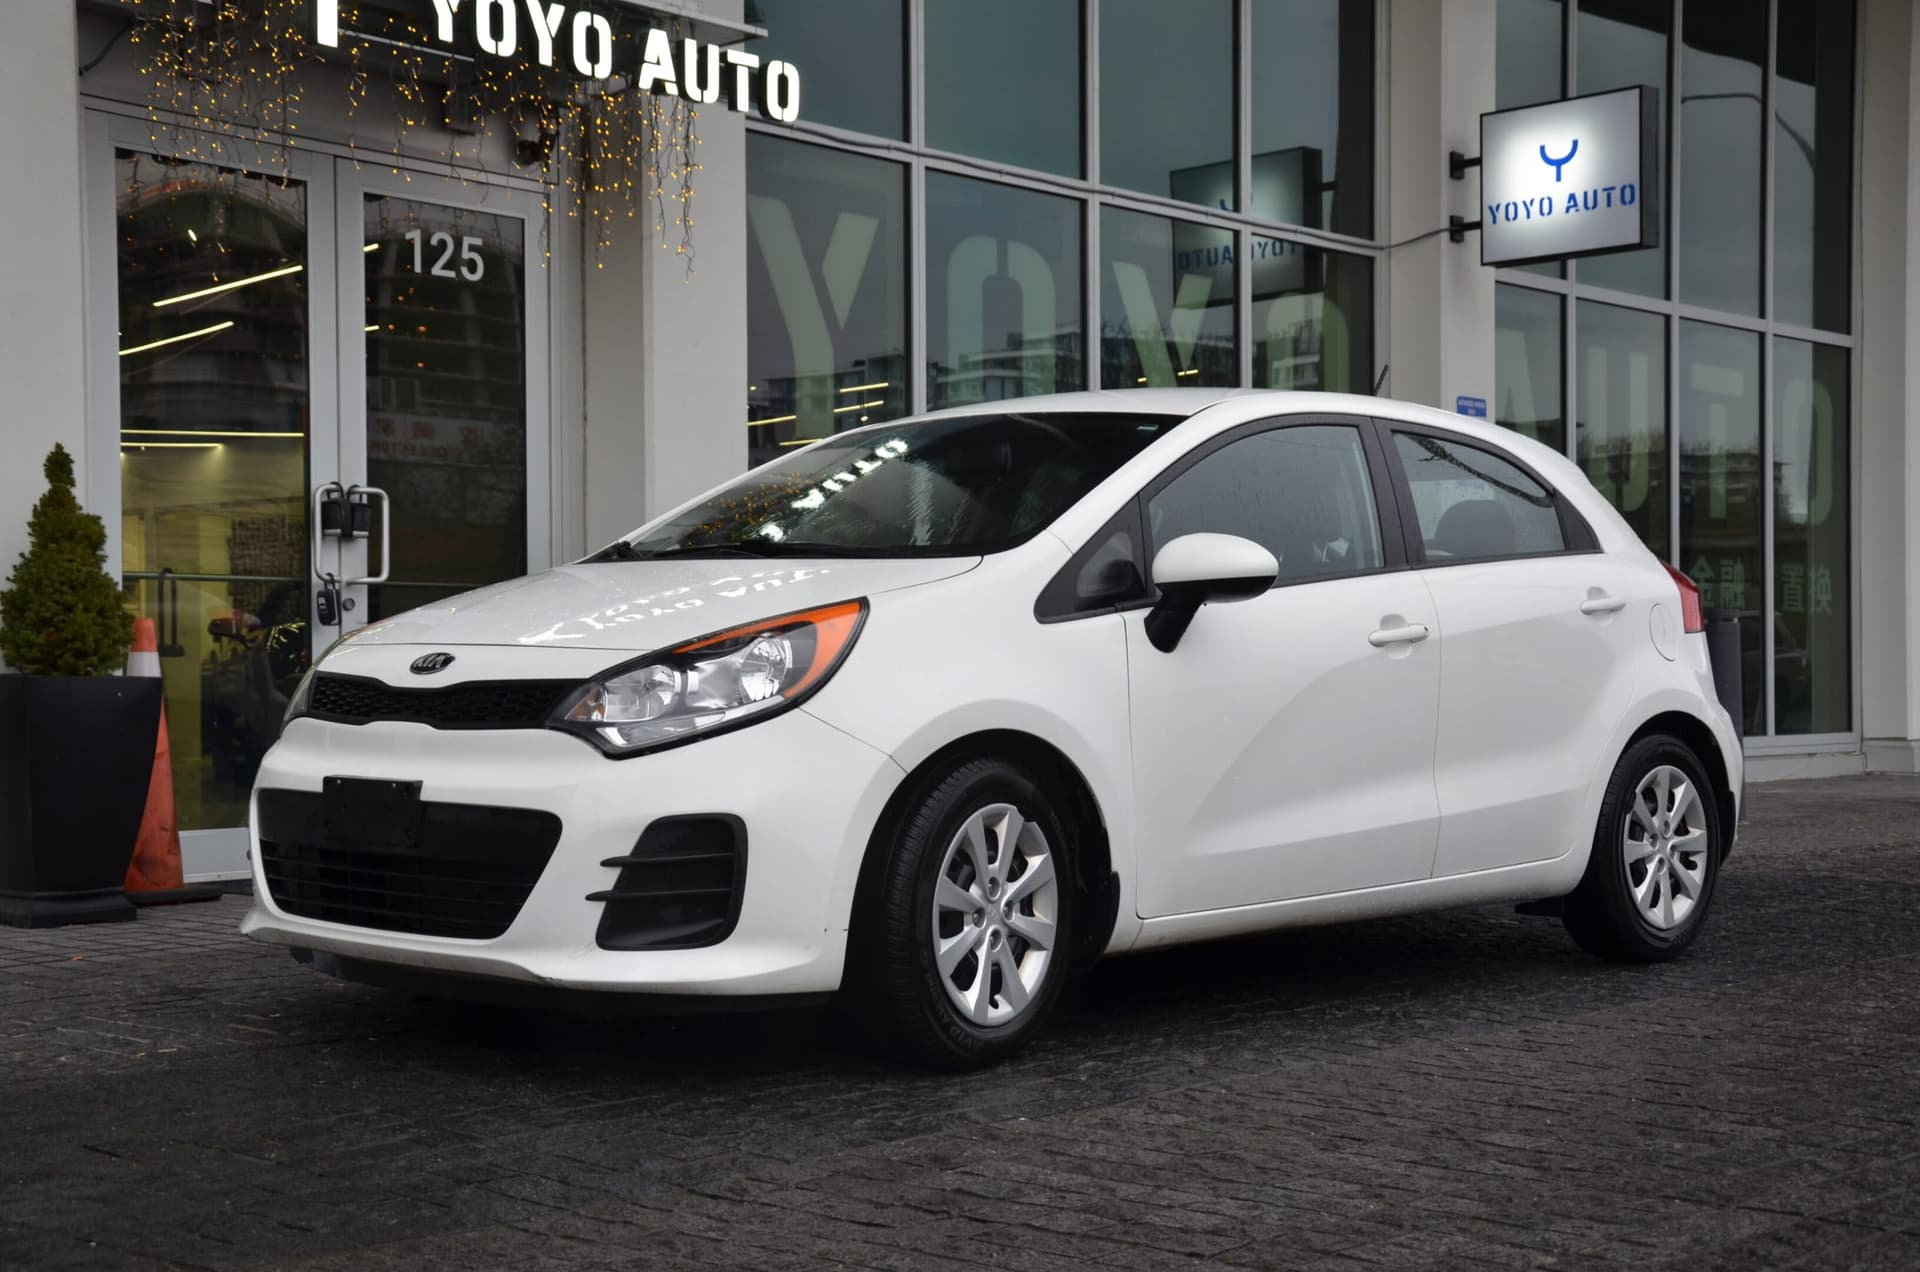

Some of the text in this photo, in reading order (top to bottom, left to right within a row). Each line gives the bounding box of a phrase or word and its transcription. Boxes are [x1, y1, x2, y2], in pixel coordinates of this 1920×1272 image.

[432, 0, 613, 80] YOYO
[639, 28, 801, 123] AUTO
[1487, 183, 1636, 225] YOYO AUTO
[404, 228, 485, 282] 125
[1690, 556, 1745, 609] 金融
